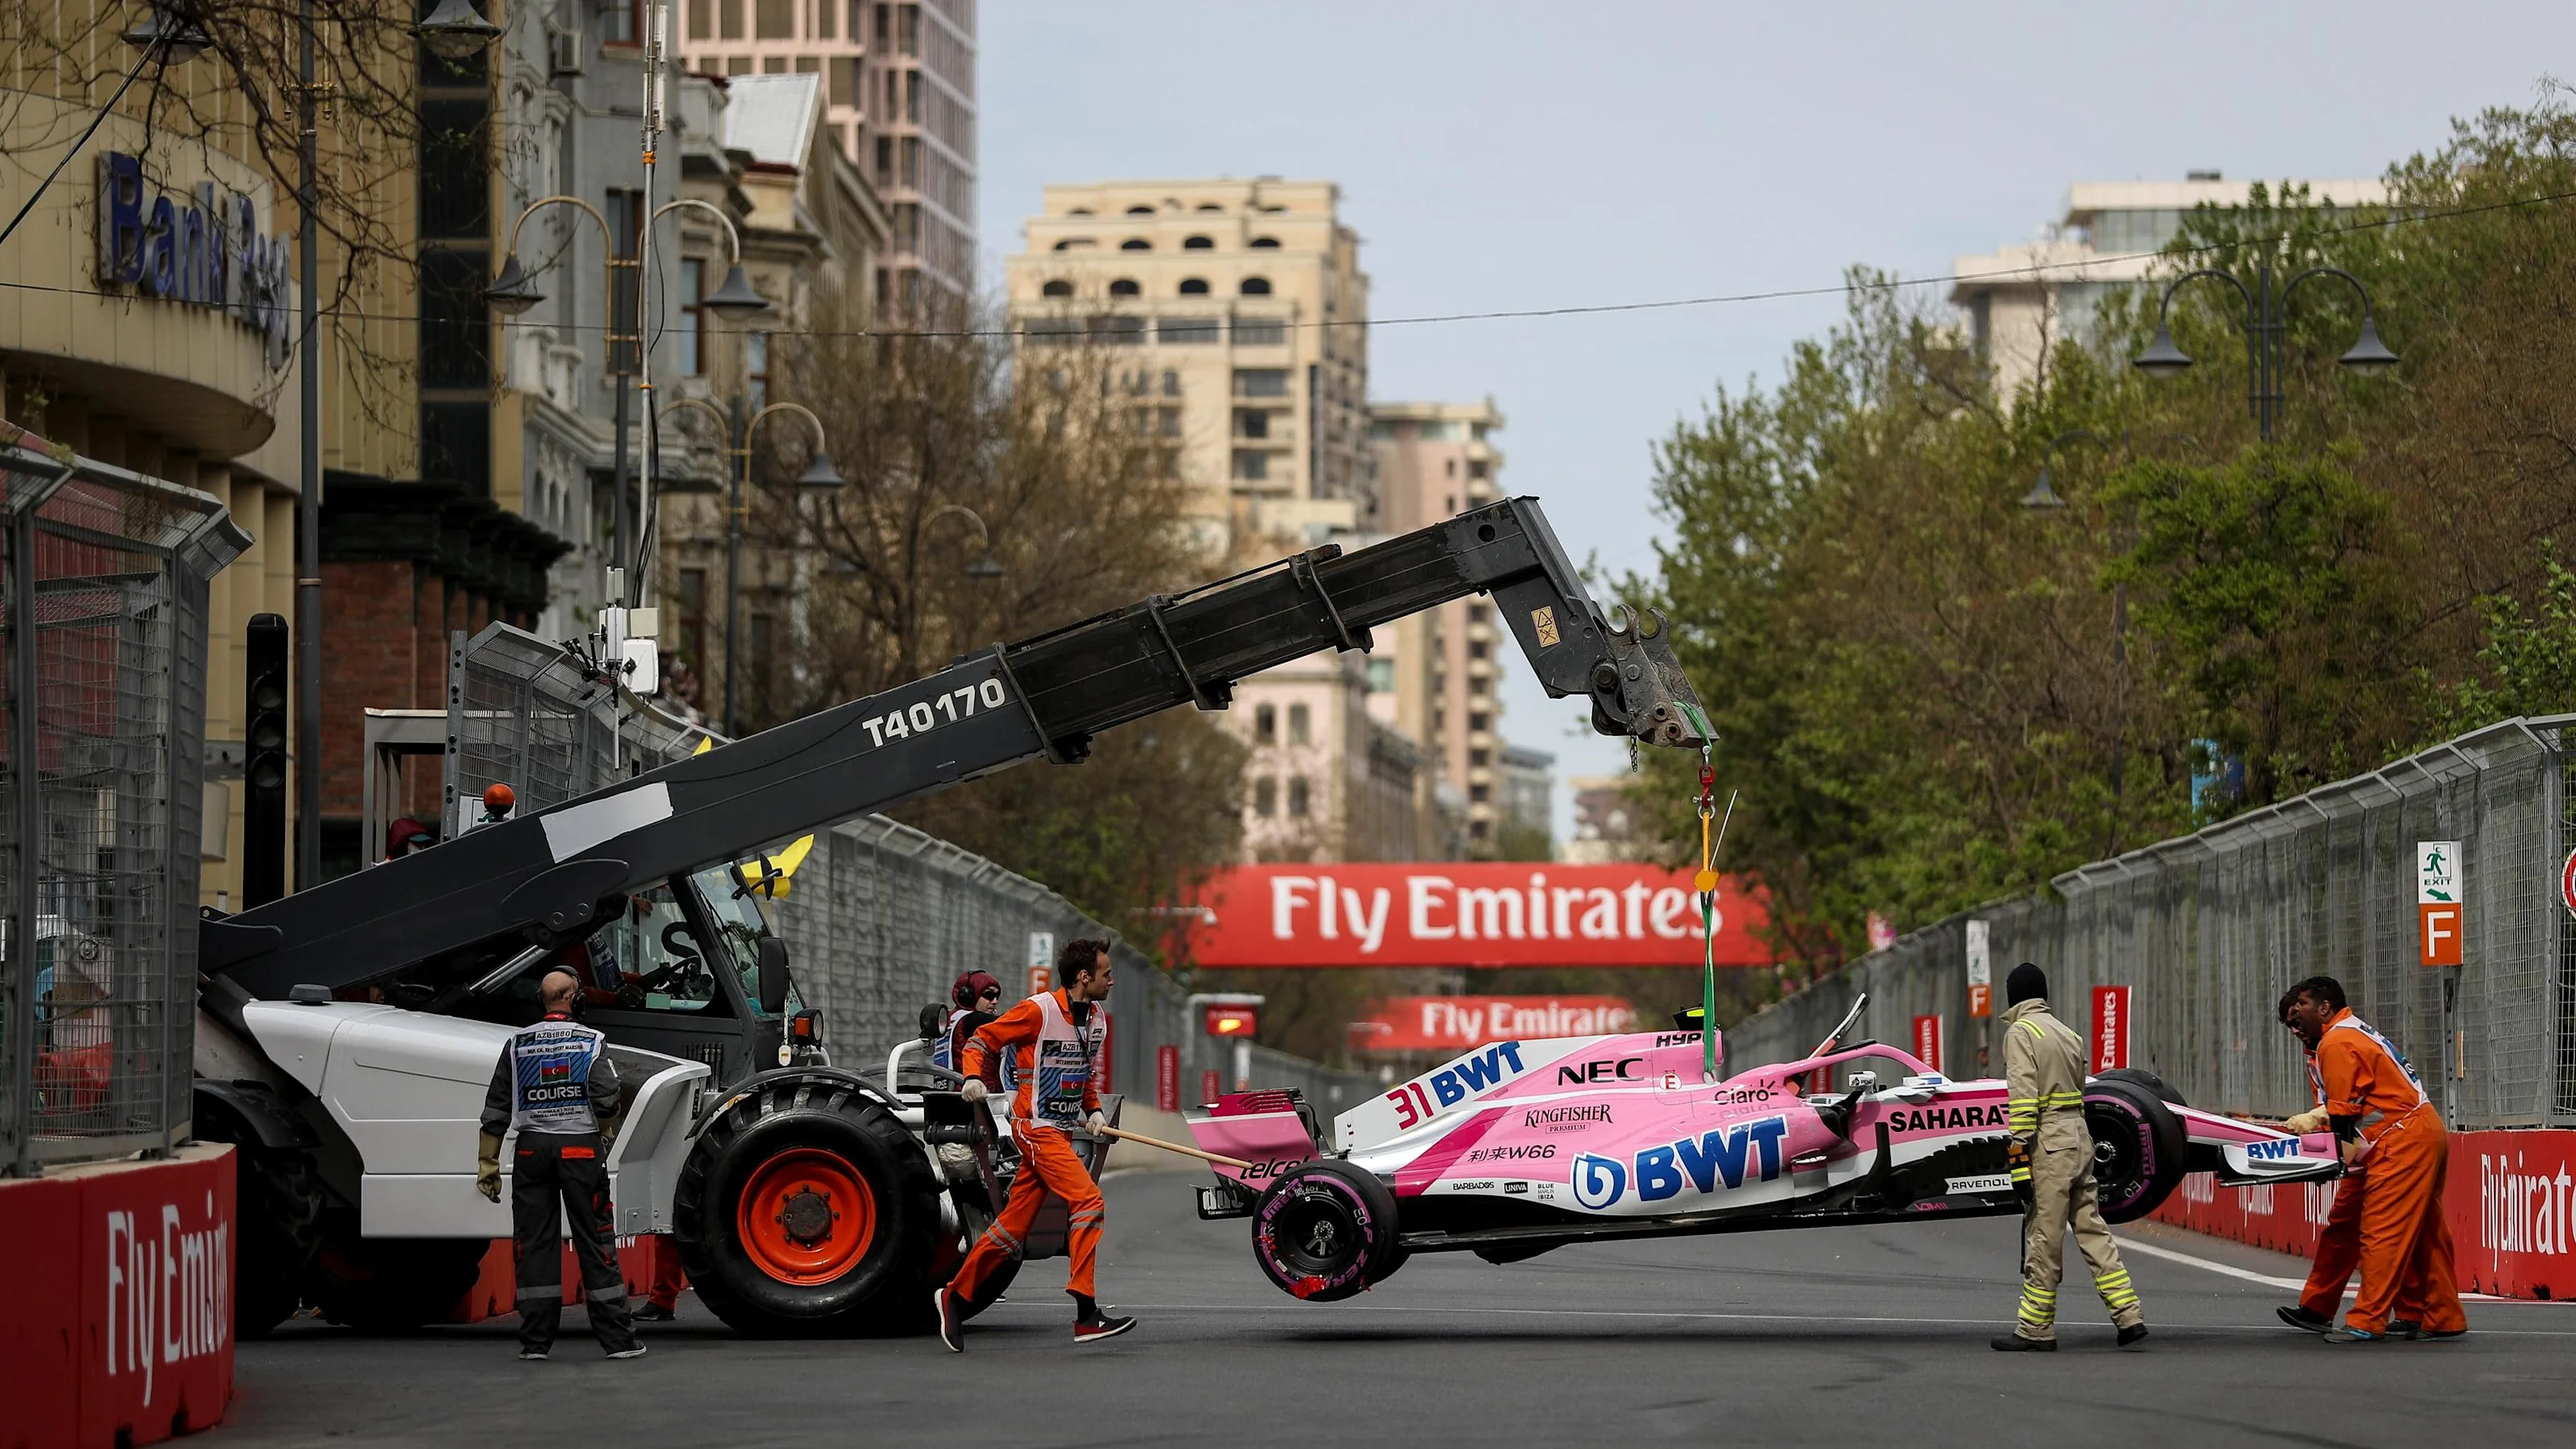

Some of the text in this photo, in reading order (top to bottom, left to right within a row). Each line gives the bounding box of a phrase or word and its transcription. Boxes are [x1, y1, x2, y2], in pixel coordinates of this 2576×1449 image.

[99, 151, 226, 312] Bank
[862, 678, 1005, 747] T40170
[1270, 873, 1723, 953] Fly Emirates
[2427, 911, 2454, 957] F
[1971, 987, 1987, 1014] F
[1422, 1002, 1483, 1042] Fly
[2101, 991, 2116, 1070] Emirates
[1656, 1033, 1704, 1047] HYP
[1921, 1018, 1933, 1065] mirates
[1386, 1041, 1524, 1130] 31 BWT
[1558, 1058, 1645, 1086] NEC
[1665, 1075, 1676, 1089] E
[527, 1086, 582, 1101] COURSE
[1525, 1104, 1613, 1127] KINGFISHER
[1890, 1105, 2004, 1132] SAHARA
[1635, 1117, 1787, 1202] BWT
[2247, 1138, 2301, 1159] BWT
[1453, 1182, 1494, 1191] BARBADOS
[1505, 1184, 1528, 1194] UNIVA
[1951, 1179, 2009, 1190] RAVENOL
[2481, 1154, 2499, 1272] Fly
[108, 1211, 156, 1407] Fly
